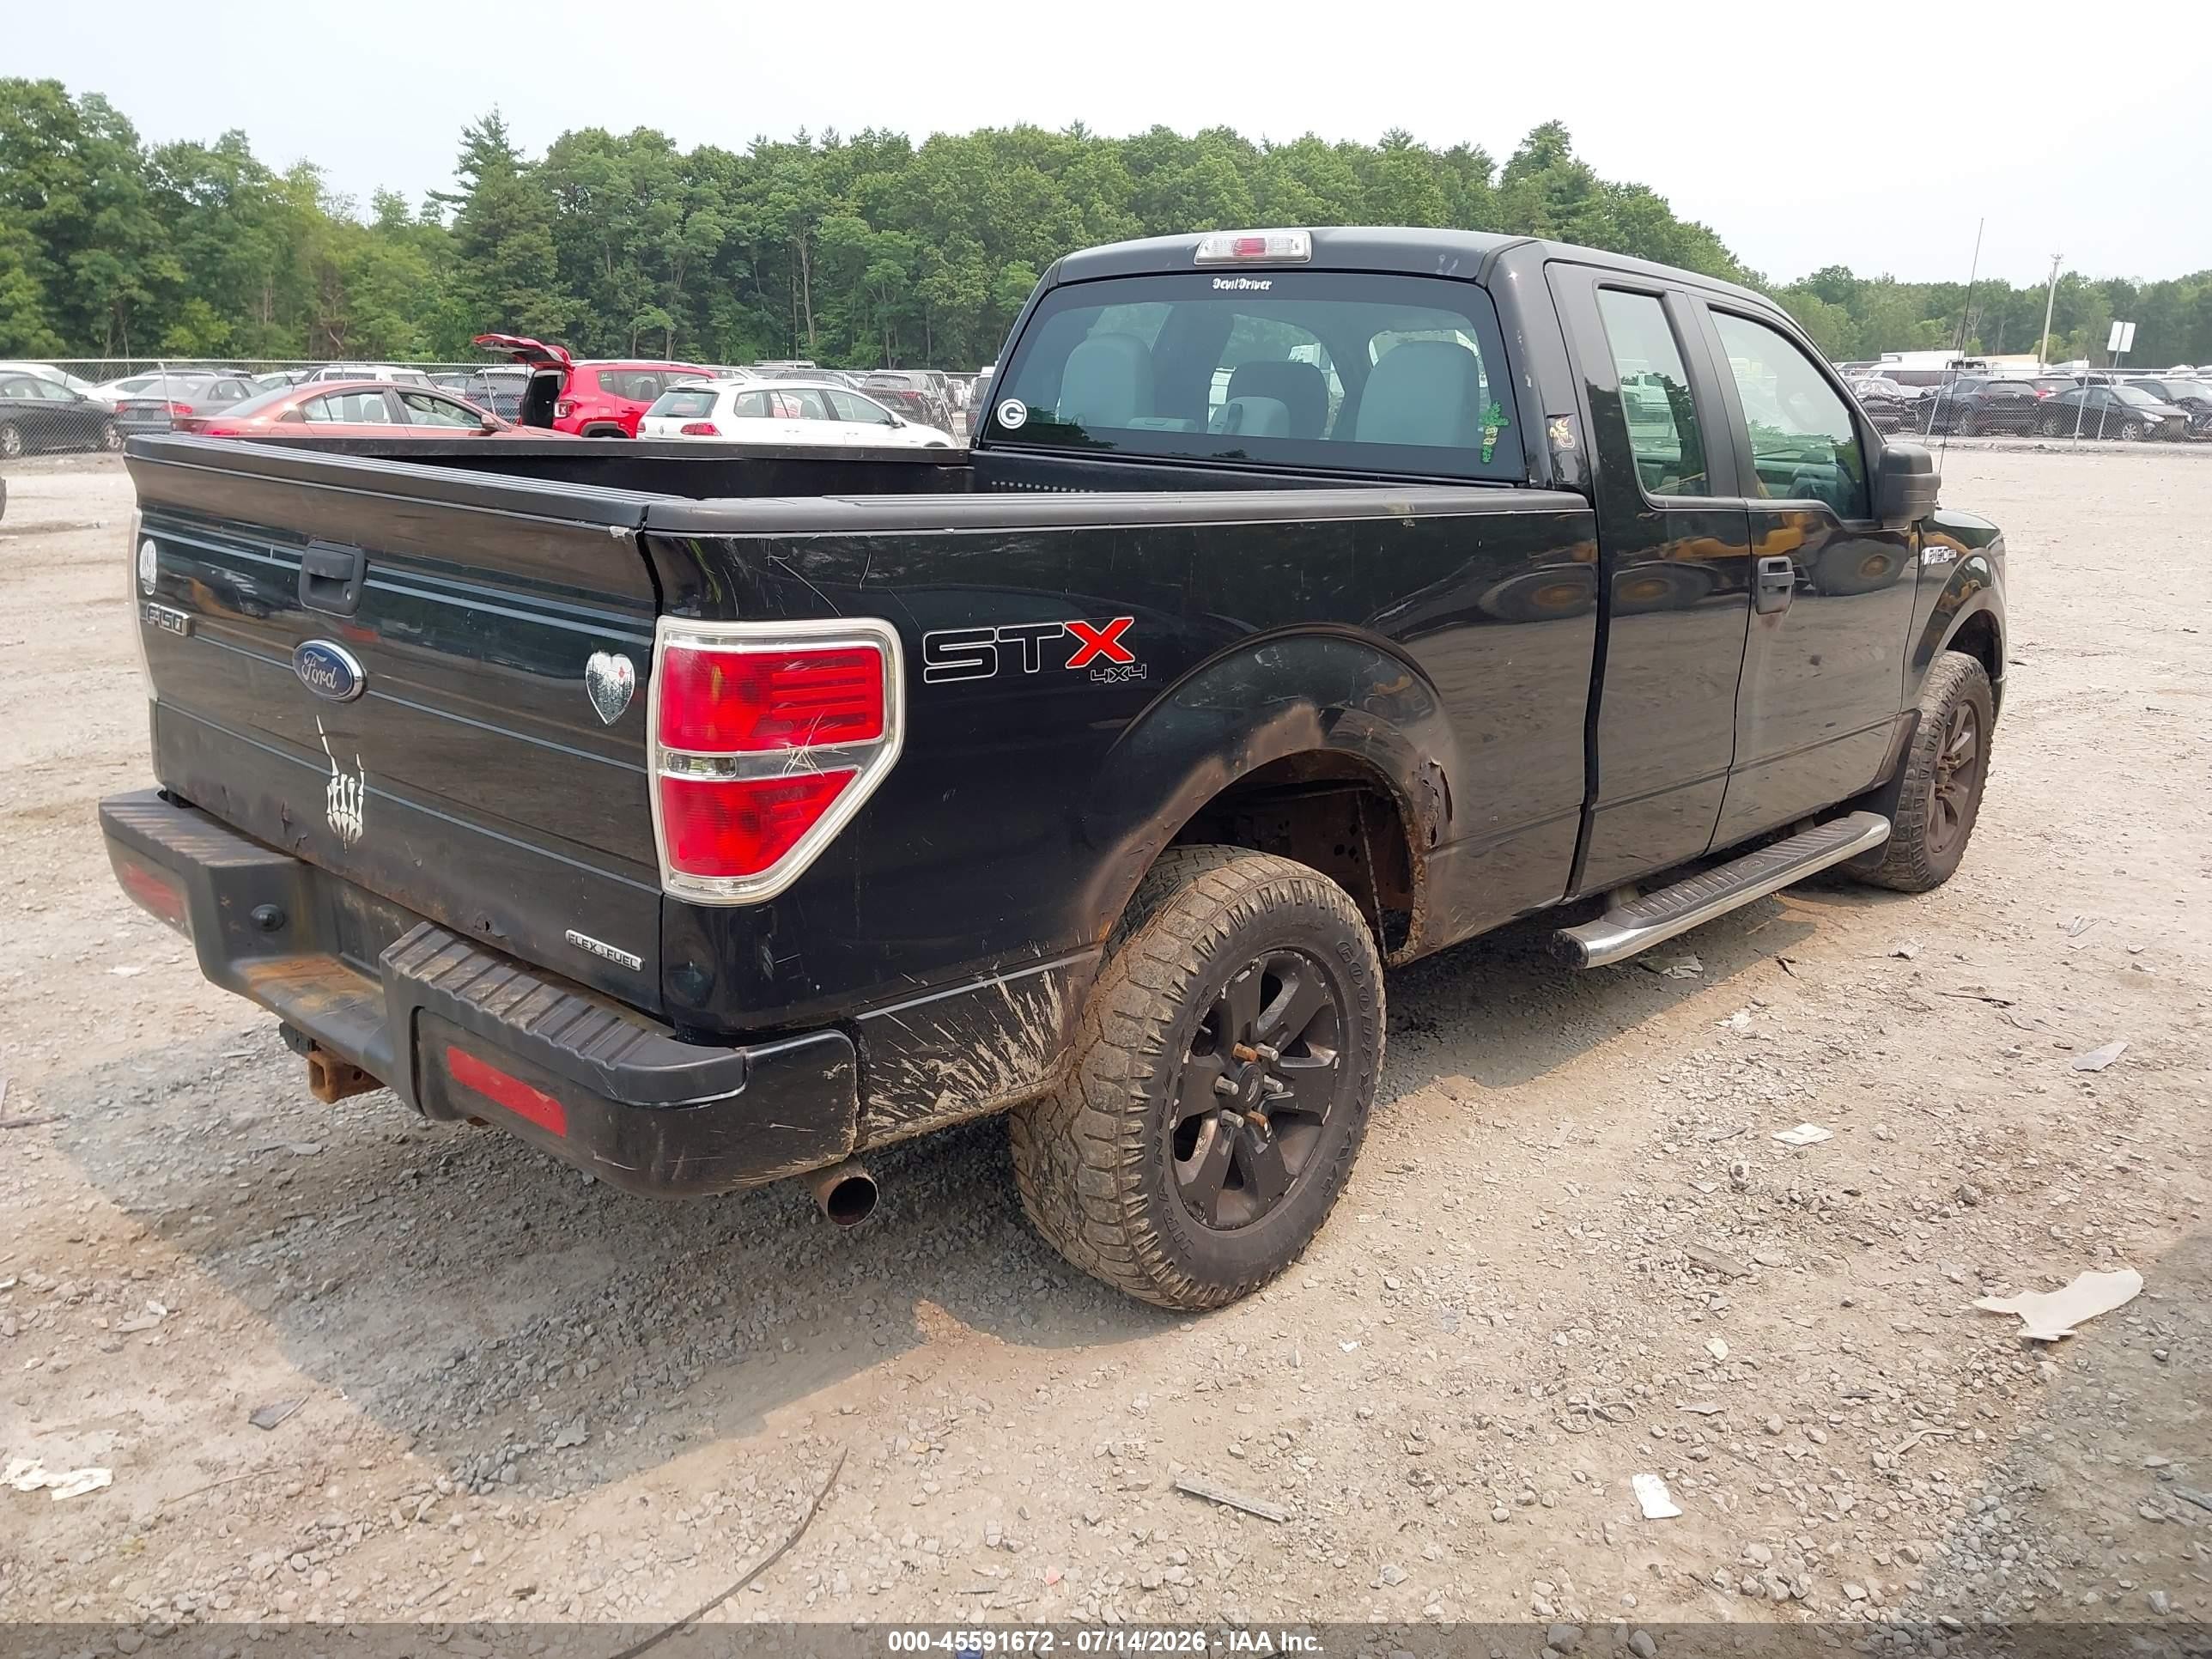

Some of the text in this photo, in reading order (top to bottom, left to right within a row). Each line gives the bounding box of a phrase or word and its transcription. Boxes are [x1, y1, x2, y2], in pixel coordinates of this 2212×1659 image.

[1212, 277, 1273, 290] DevilDriver
[1000, 402, 1025, 426] G
[923, 617, 1135, 684] STX
[301, 650, 337, 690] Ford
[568, 933, 638, 969] FLEX FUEL
